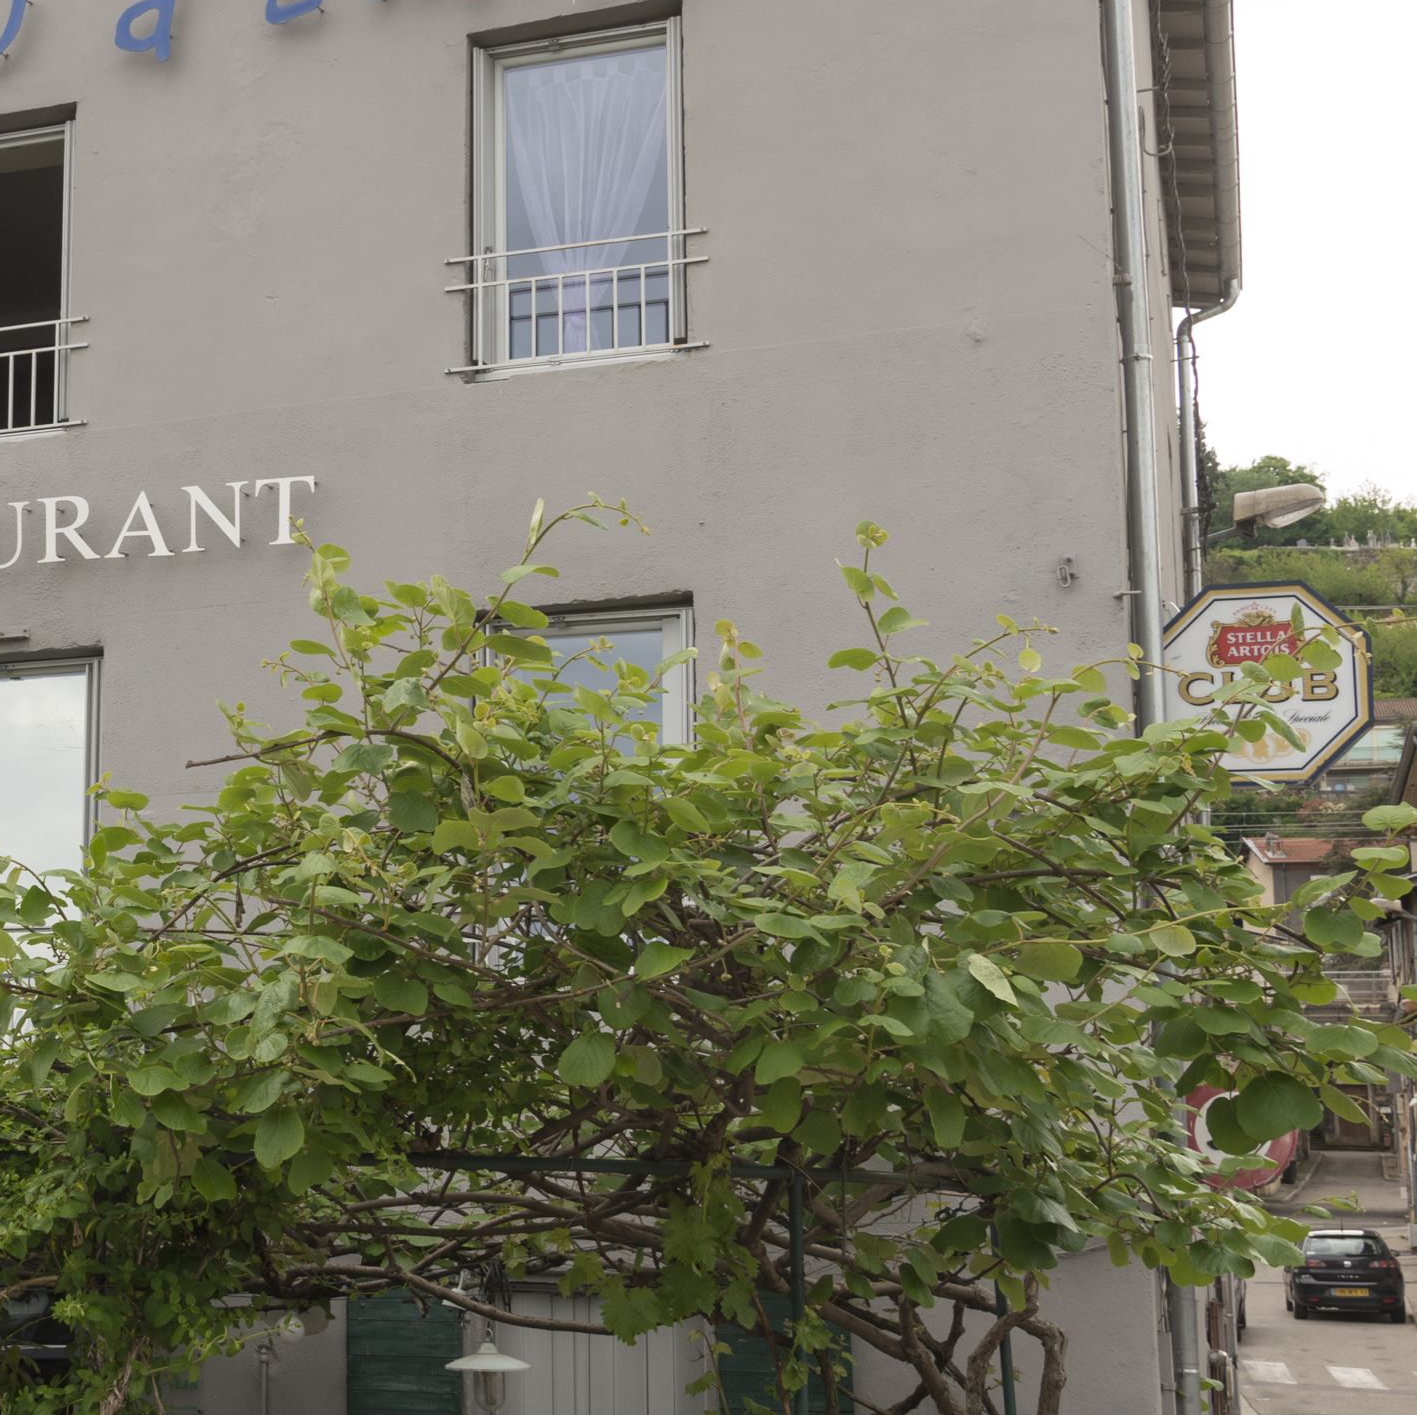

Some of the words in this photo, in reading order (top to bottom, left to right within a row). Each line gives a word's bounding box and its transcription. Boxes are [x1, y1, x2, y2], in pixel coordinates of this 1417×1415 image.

[1232, 604, 1250, 617] ANNO
[1226, 630, 1288, 644] STELLA
[1227, 643, 1290, 658] ARTOIS
